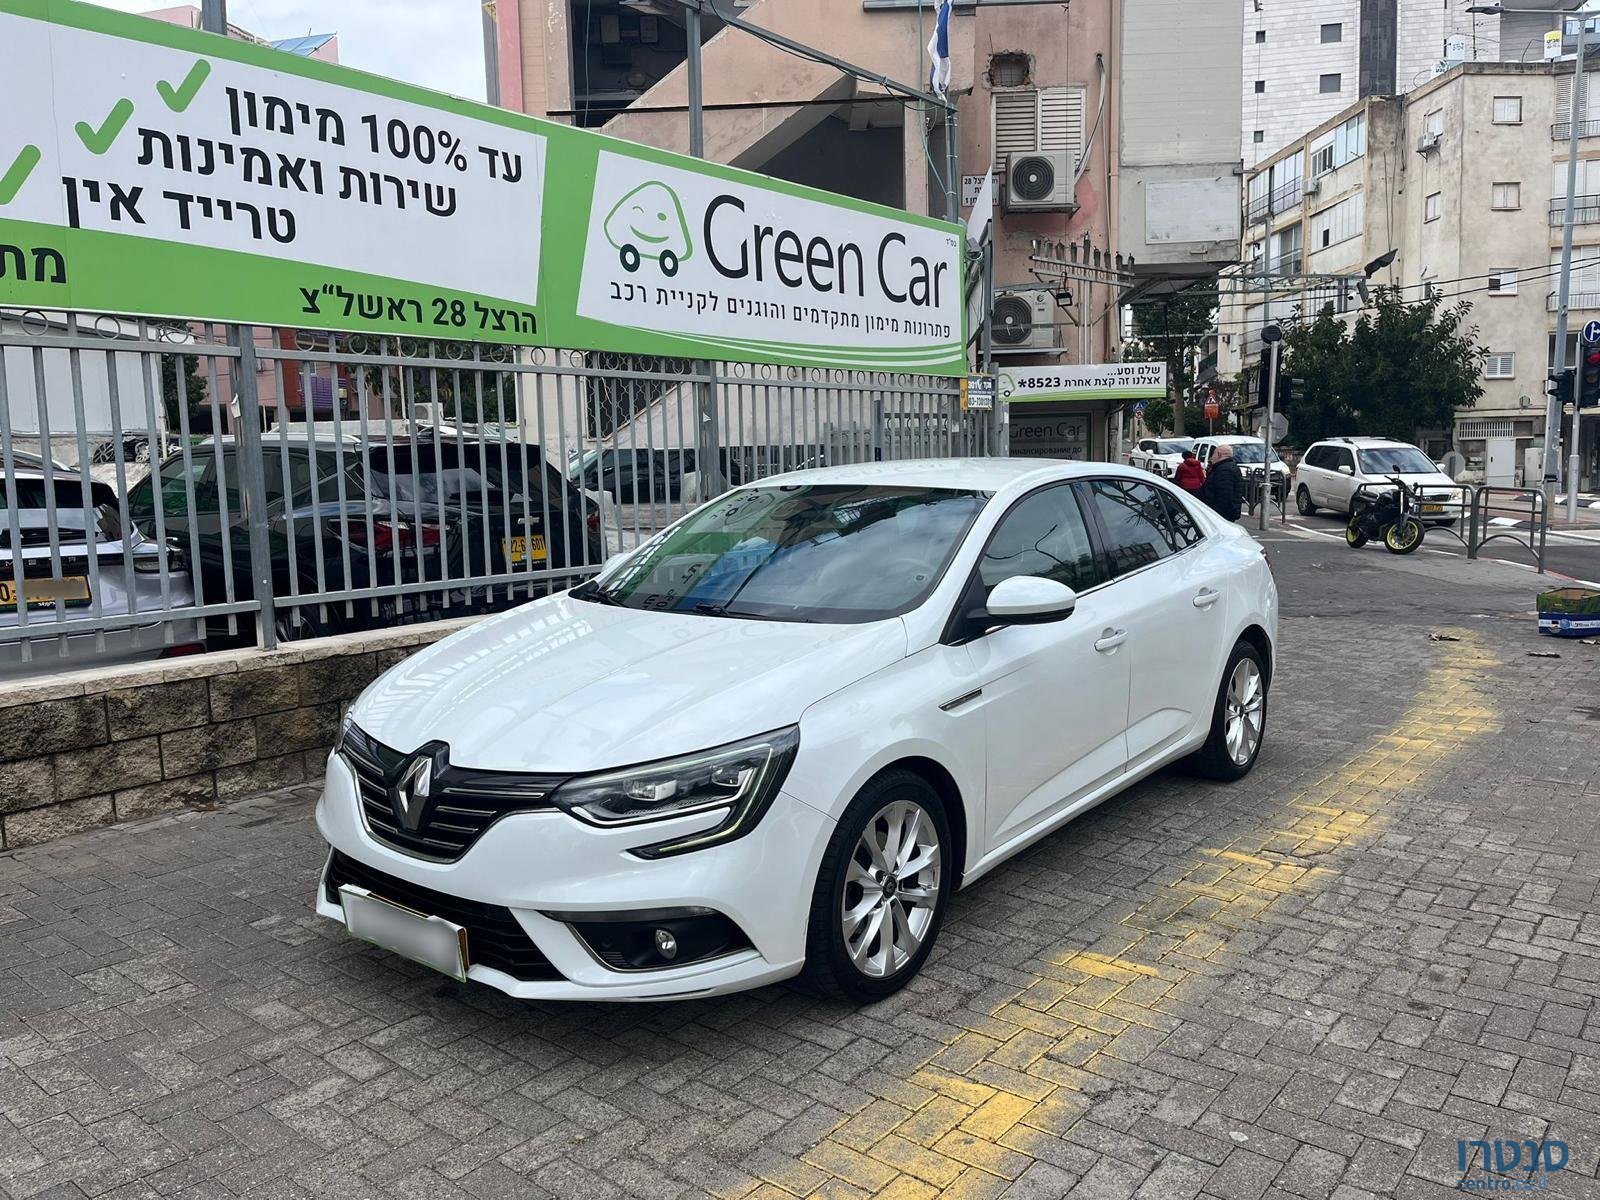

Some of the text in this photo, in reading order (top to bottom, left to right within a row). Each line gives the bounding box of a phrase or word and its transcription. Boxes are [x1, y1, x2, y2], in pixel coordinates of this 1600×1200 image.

[225, 87, 522, 183] עד 100% מימון
[137, 128, 456, 217] שירות ואמינות
[62, 177, 296, 244] טרייד אין
[703, 194, 947, 308] Green Car
[431, 298, 466, 327] 28
[474, 301, 537, 334] הרצל
[610, 281, 951, 338] פתרונות מימון מתקדמים והוגנים לקניית רכב
[1064, 378, 1091, 387] אחרת
[1094, 376, 1115, 388] קצת
[1118, 377, 1130, 386] זה
[1132, 375, 1160, 385] אצלנו
[1138, 365, 1160, 375] שלם
[1057, 421, 1082, 437] Car
